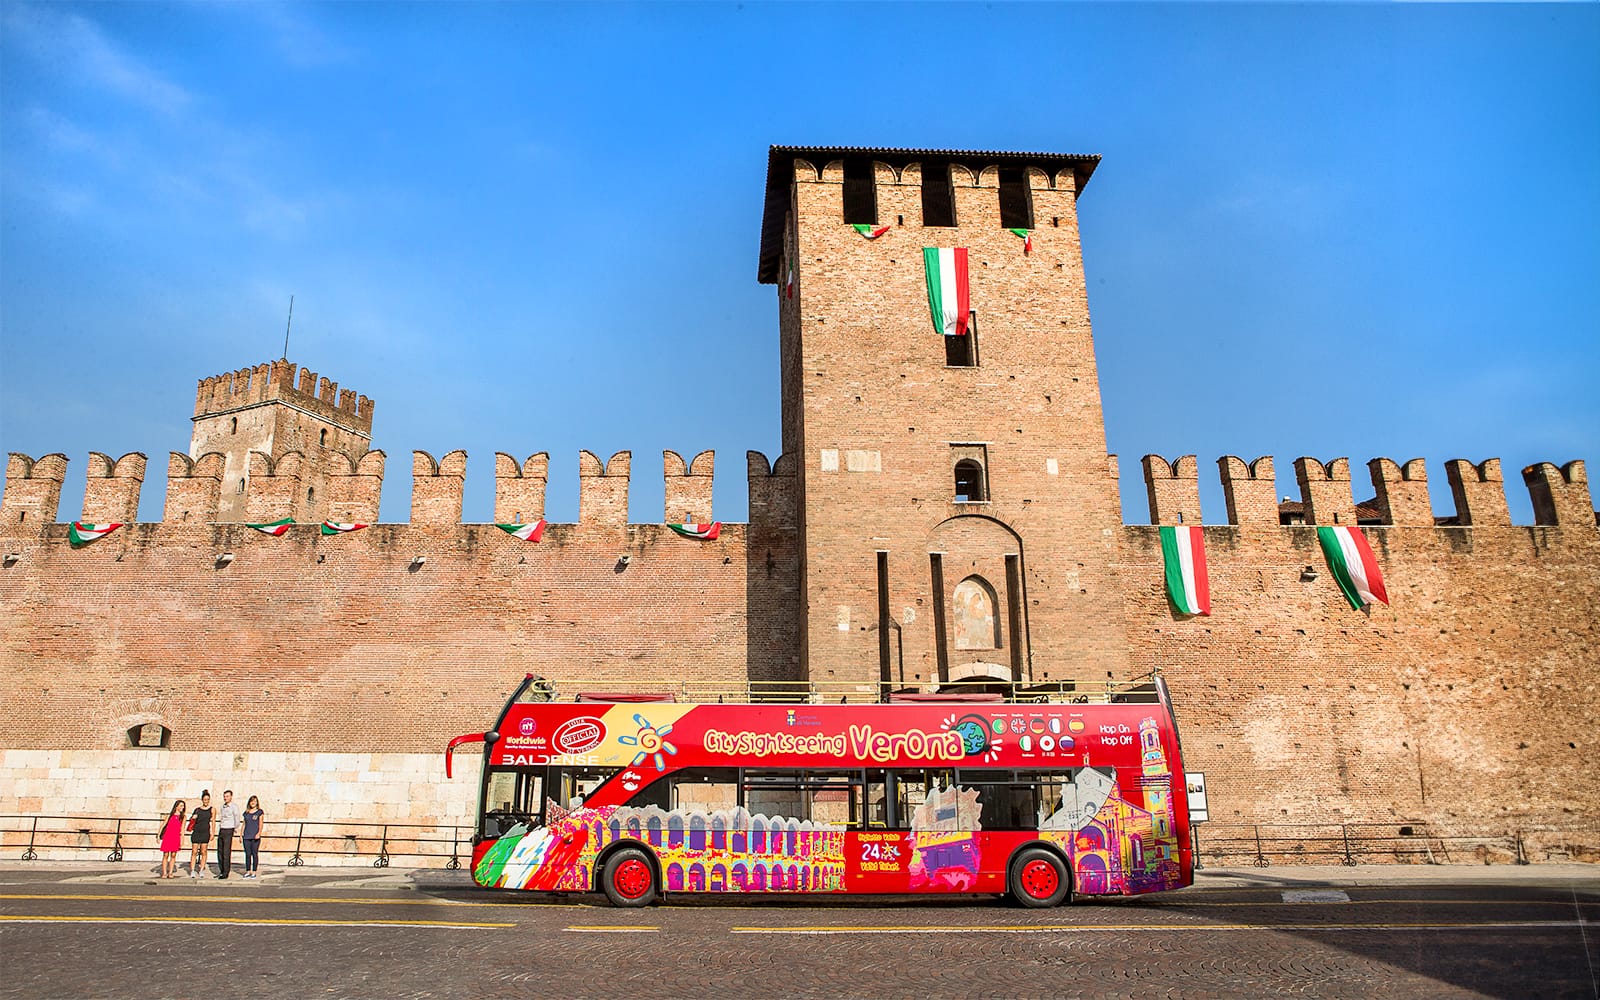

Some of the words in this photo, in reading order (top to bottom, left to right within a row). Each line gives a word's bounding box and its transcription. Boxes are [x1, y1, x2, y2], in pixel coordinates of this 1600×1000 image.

[1099, 725, 1117, 734] Hop
[1118, 724, 1130, 734] On
[562, 727, 598, 744] OFFICIAL
[1101, 736, 1118, 746] Hop
[1120, 735, 1133, 745] Off
[502, 754, 599, 765] BALDENSE
[861, 843, 880, 861] 24
